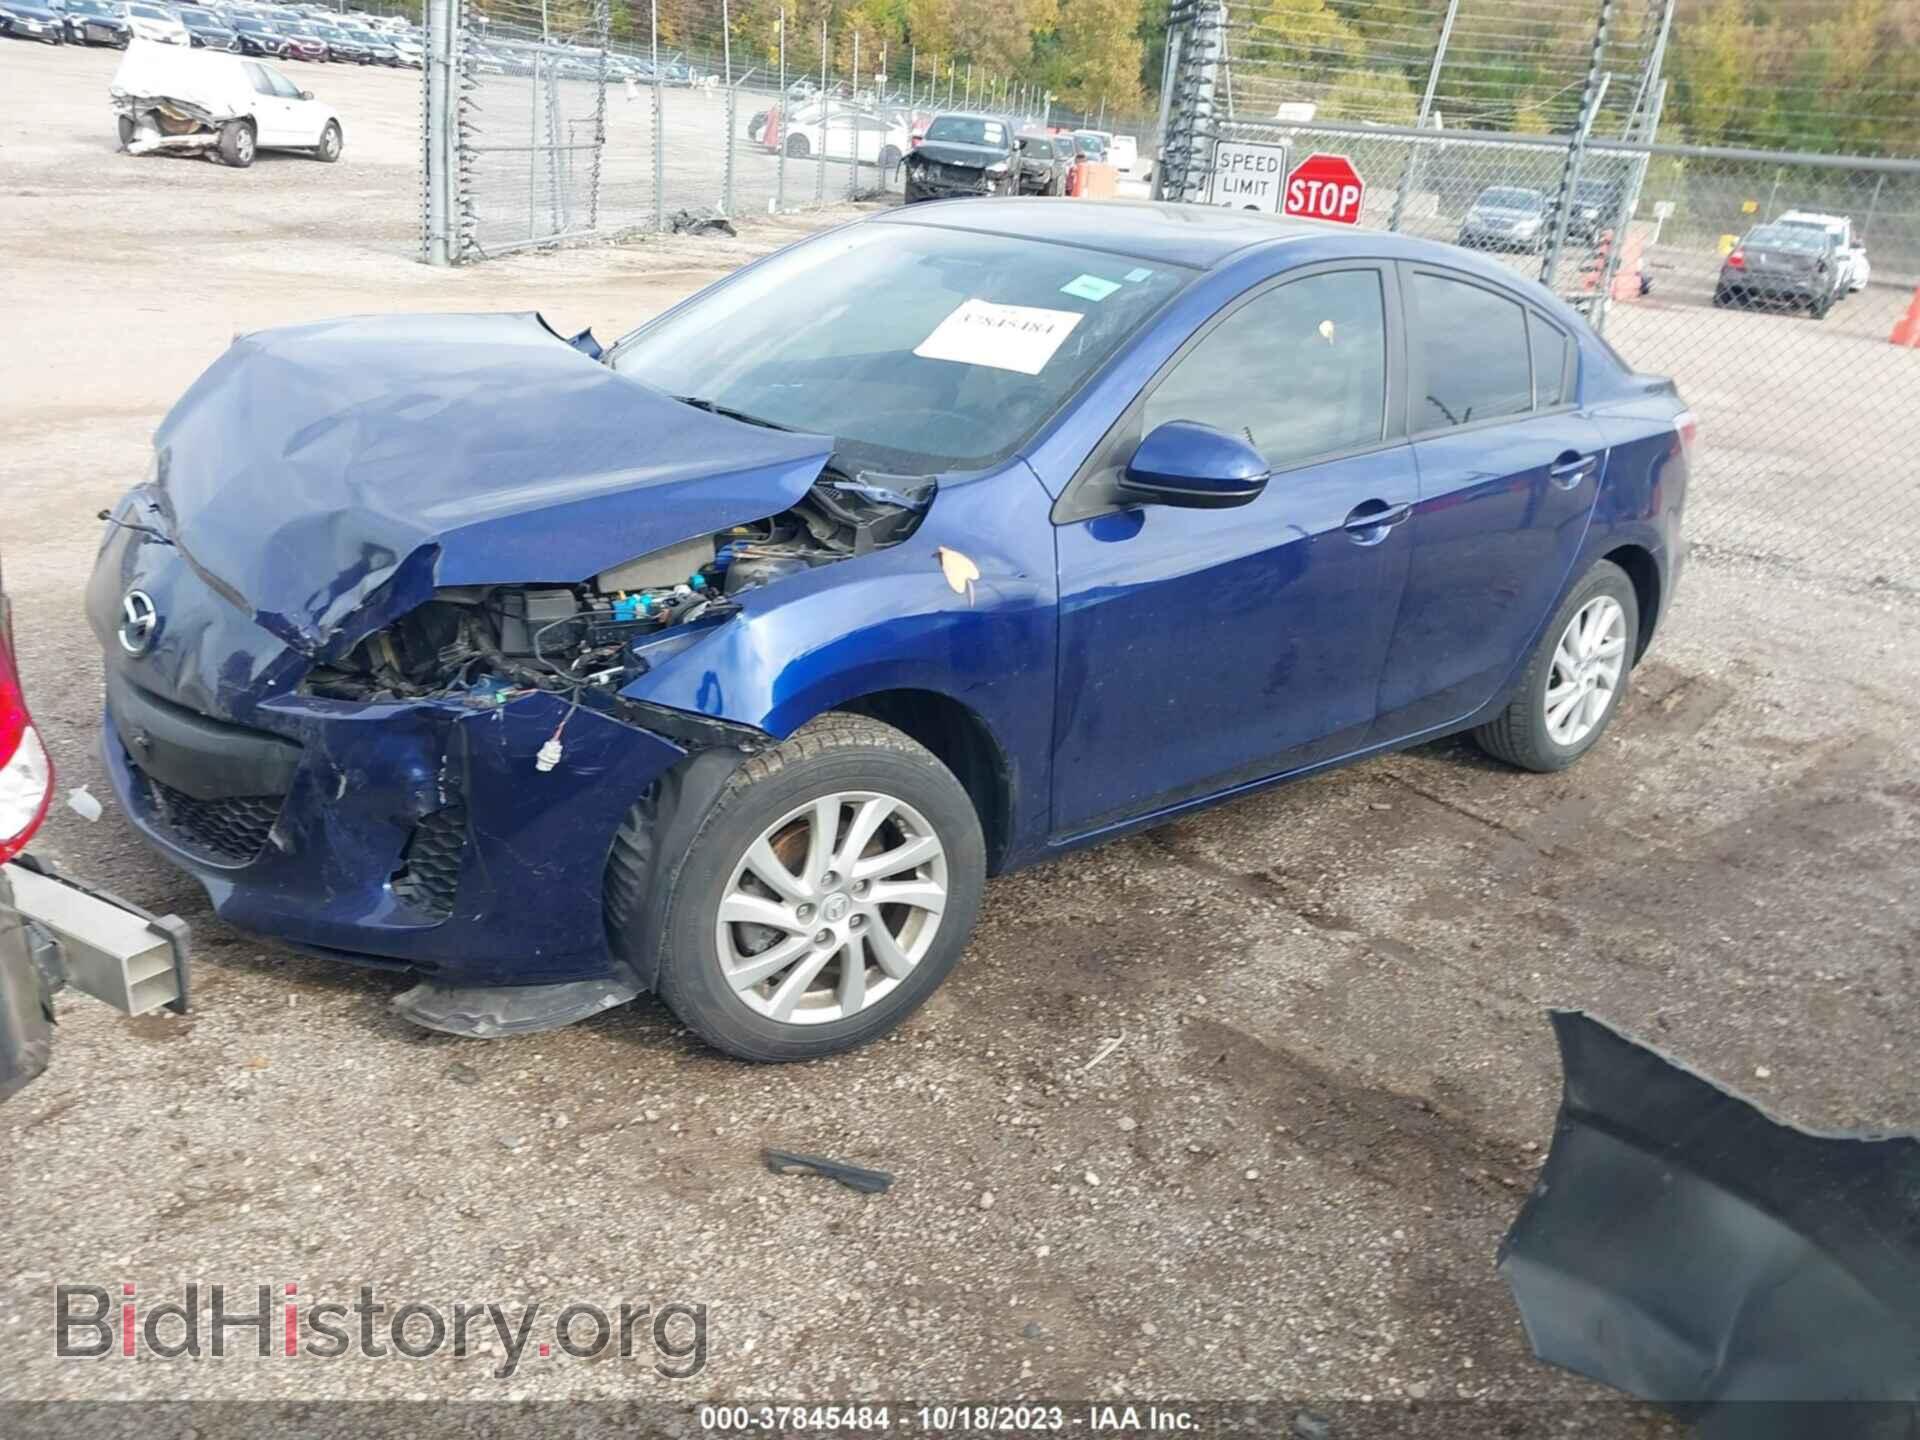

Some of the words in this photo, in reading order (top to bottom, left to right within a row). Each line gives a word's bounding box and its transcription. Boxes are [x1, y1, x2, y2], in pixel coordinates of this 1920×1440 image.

[1220, 153, 1278, 173] SPEED
[1223, 176, 1270, 196] LIMIT
[1287, 179, 1360, 217] STOP
